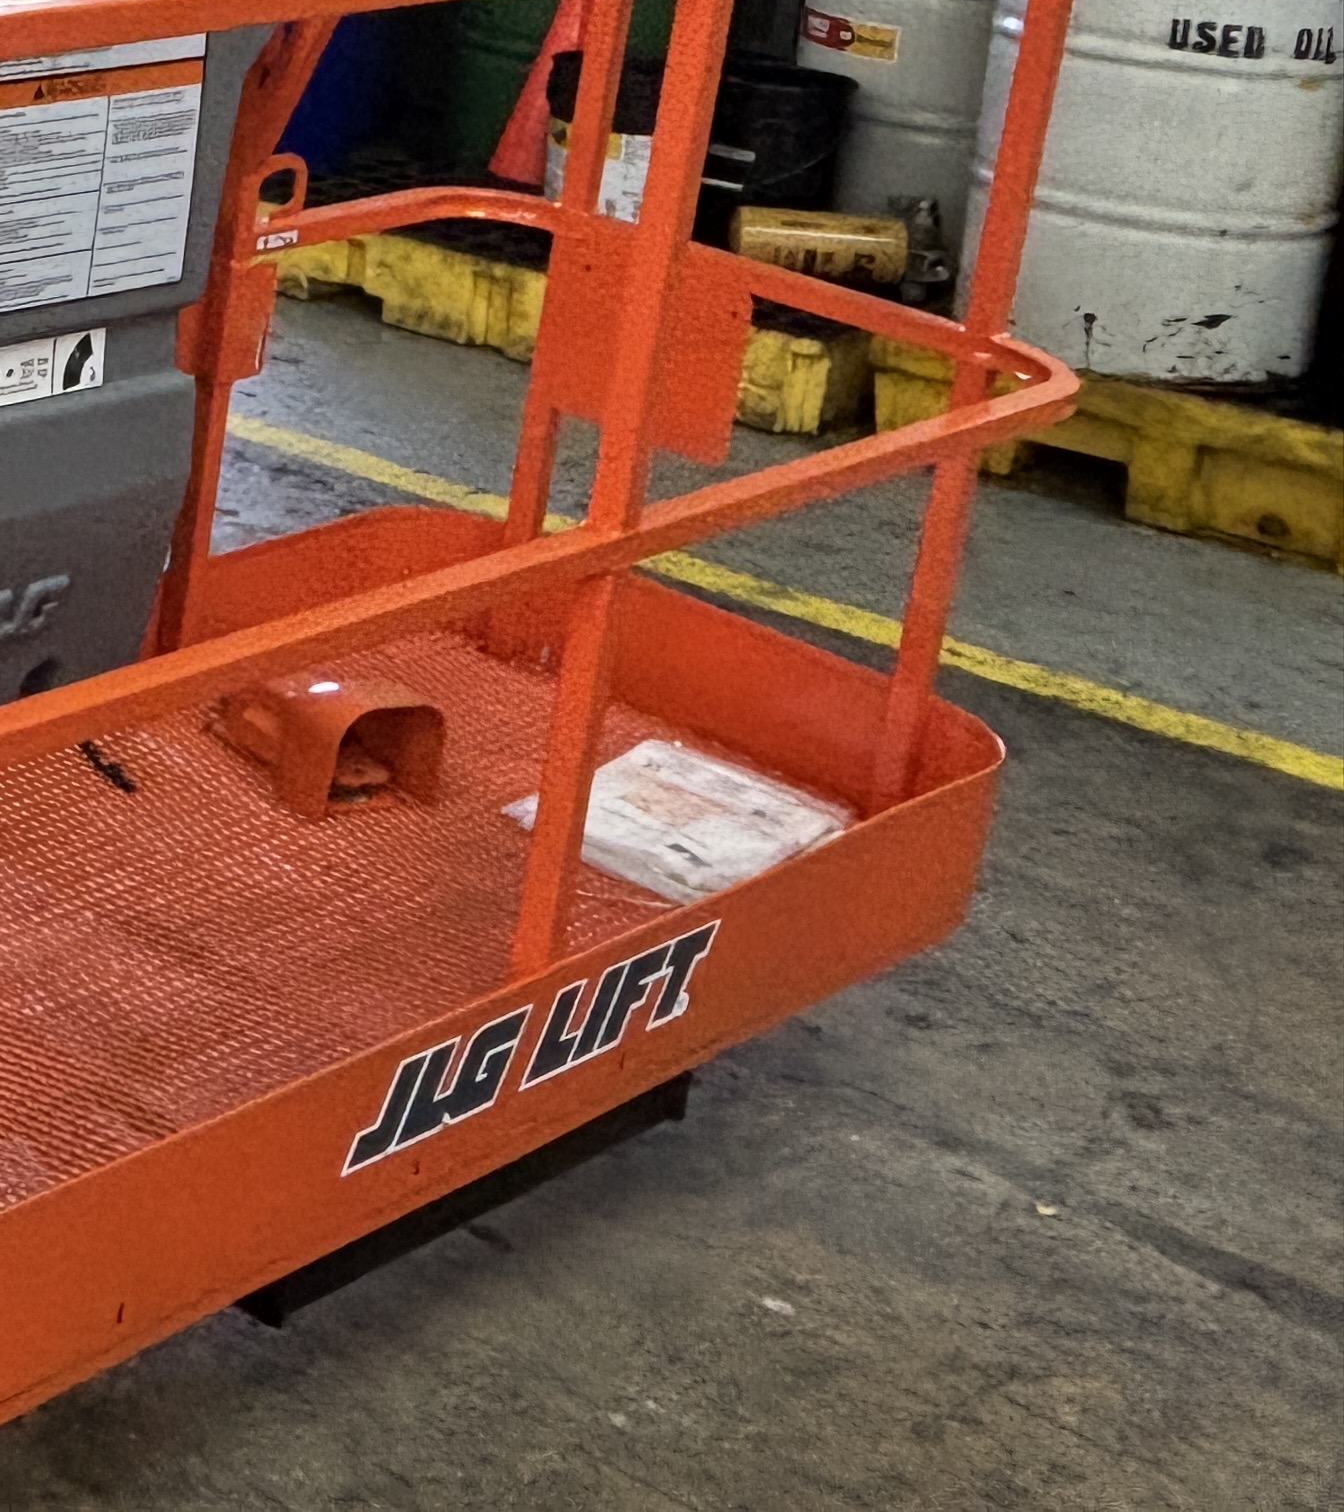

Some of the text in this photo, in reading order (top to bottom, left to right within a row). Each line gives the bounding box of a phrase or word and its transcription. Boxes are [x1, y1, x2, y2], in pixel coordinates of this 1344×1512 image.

[1168, 18, 1338, 65] USED OIL
[340, 918, 723, 1178] JLG LIFT
